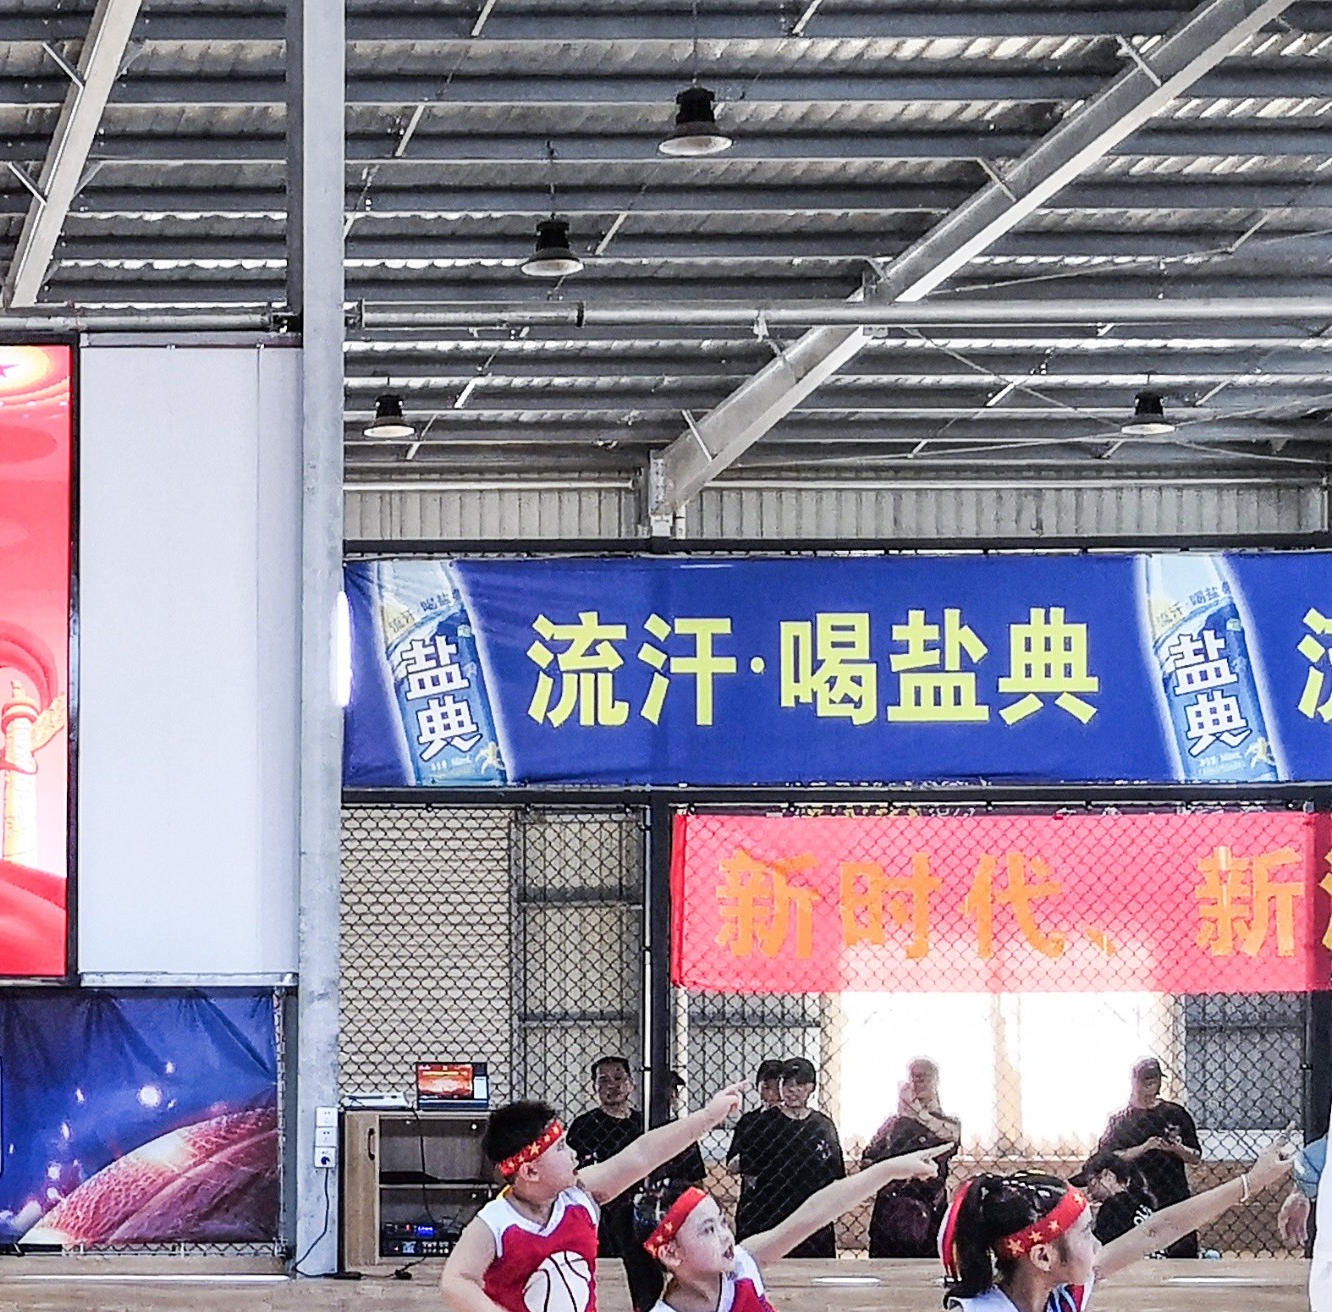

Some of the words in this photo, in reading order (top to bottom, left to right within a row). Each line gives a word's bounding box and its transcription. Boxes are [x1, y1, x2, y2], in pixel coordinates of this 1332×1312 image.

[403, 635, 483, 762] 盐典
[526, 606, 1102, 728] 流汗·喝盐典
[1174, 630, 1252, 757] 盐典
